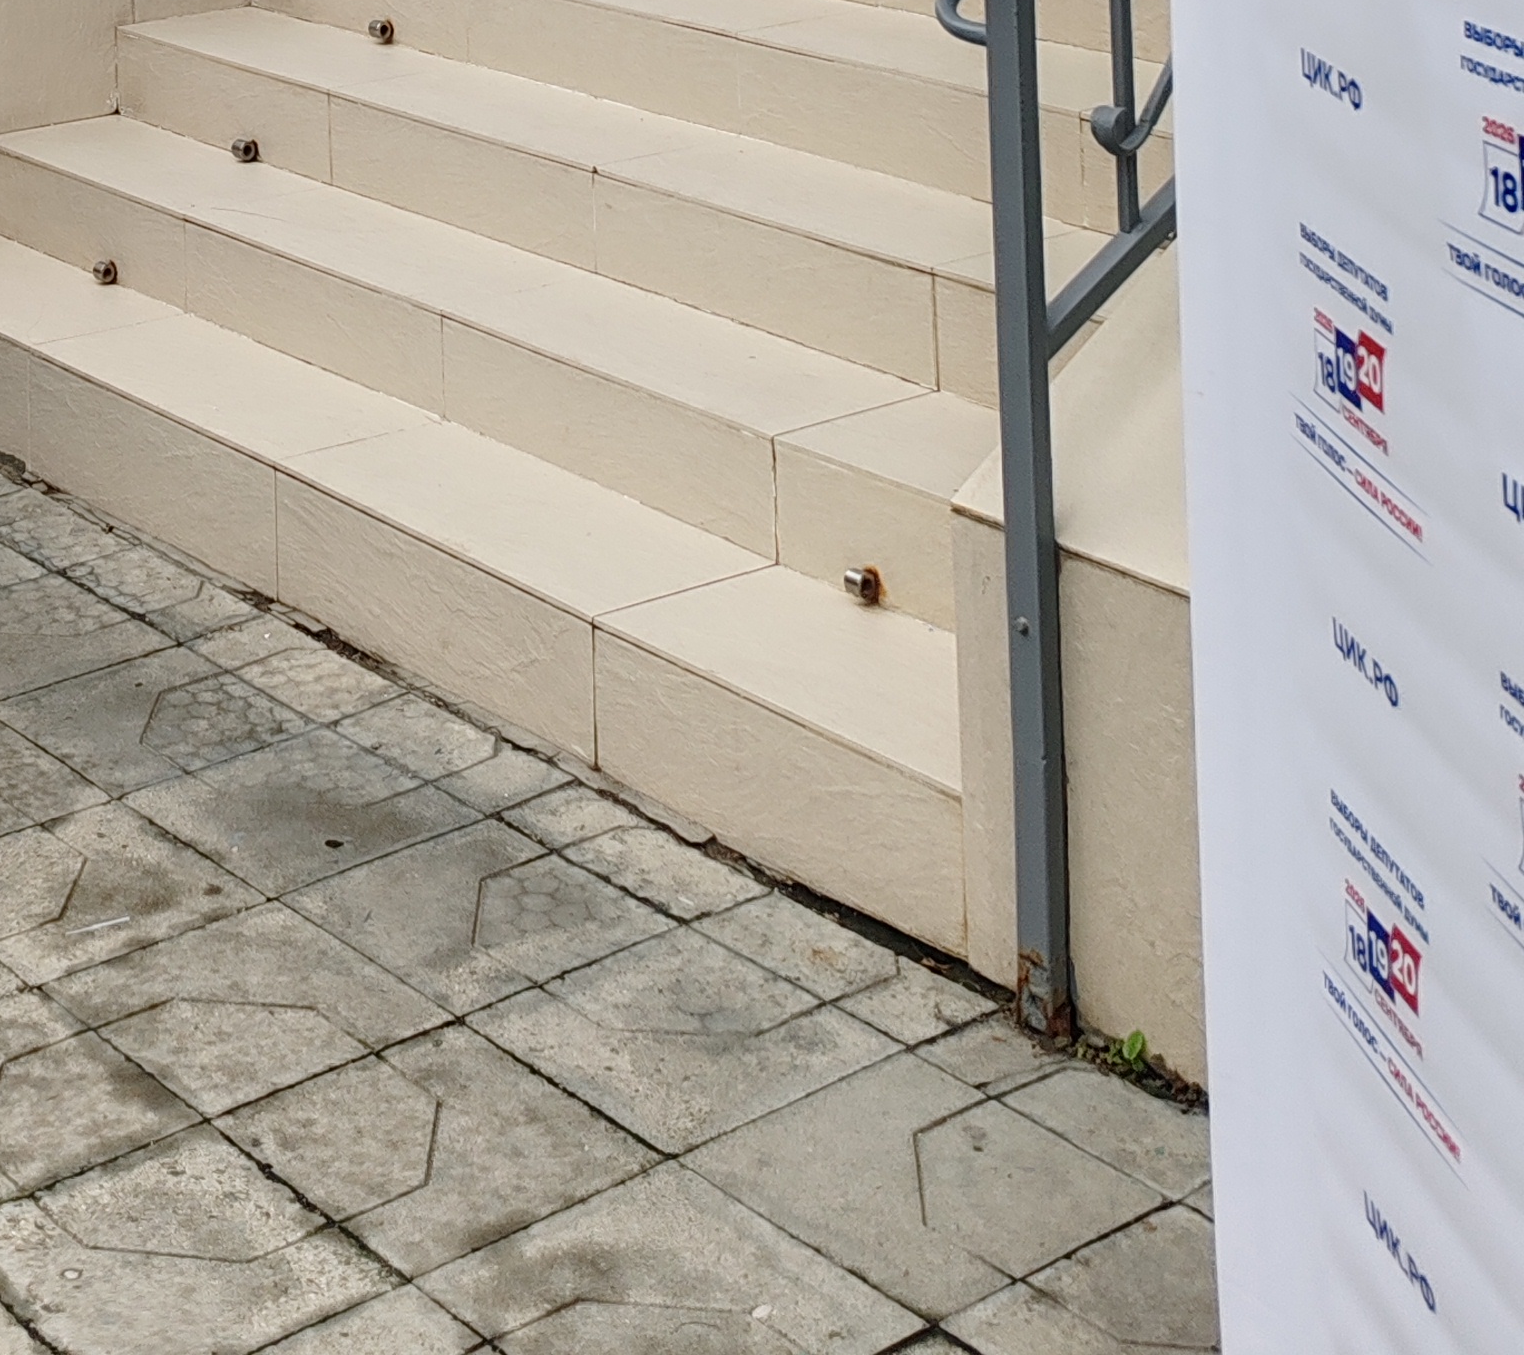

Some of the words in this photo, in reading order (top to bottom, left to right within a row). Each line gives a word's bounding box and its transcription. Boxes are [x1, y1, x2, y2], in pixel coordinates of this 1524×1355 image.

[1300, 47, 1363, 110] ЦИК.РФ
[1489, 166, 1518, 213] 18
[1446, 241, 1481, 277] ТВОЙ
[1318, 351, 1336, 394] 18
[1337, 347, 1357, 391] 19
[1357, 345, 1382, 394] 20
[1332, 615, 1400, 707] ЦИК.РФ
[1348, 924, 1367, 973] 18
[1369, 929, 1390, 980] 19
[1391, 943, 1417, 996] 20
[1362, 1189, 1437, 1315] ЦИК.РФ
